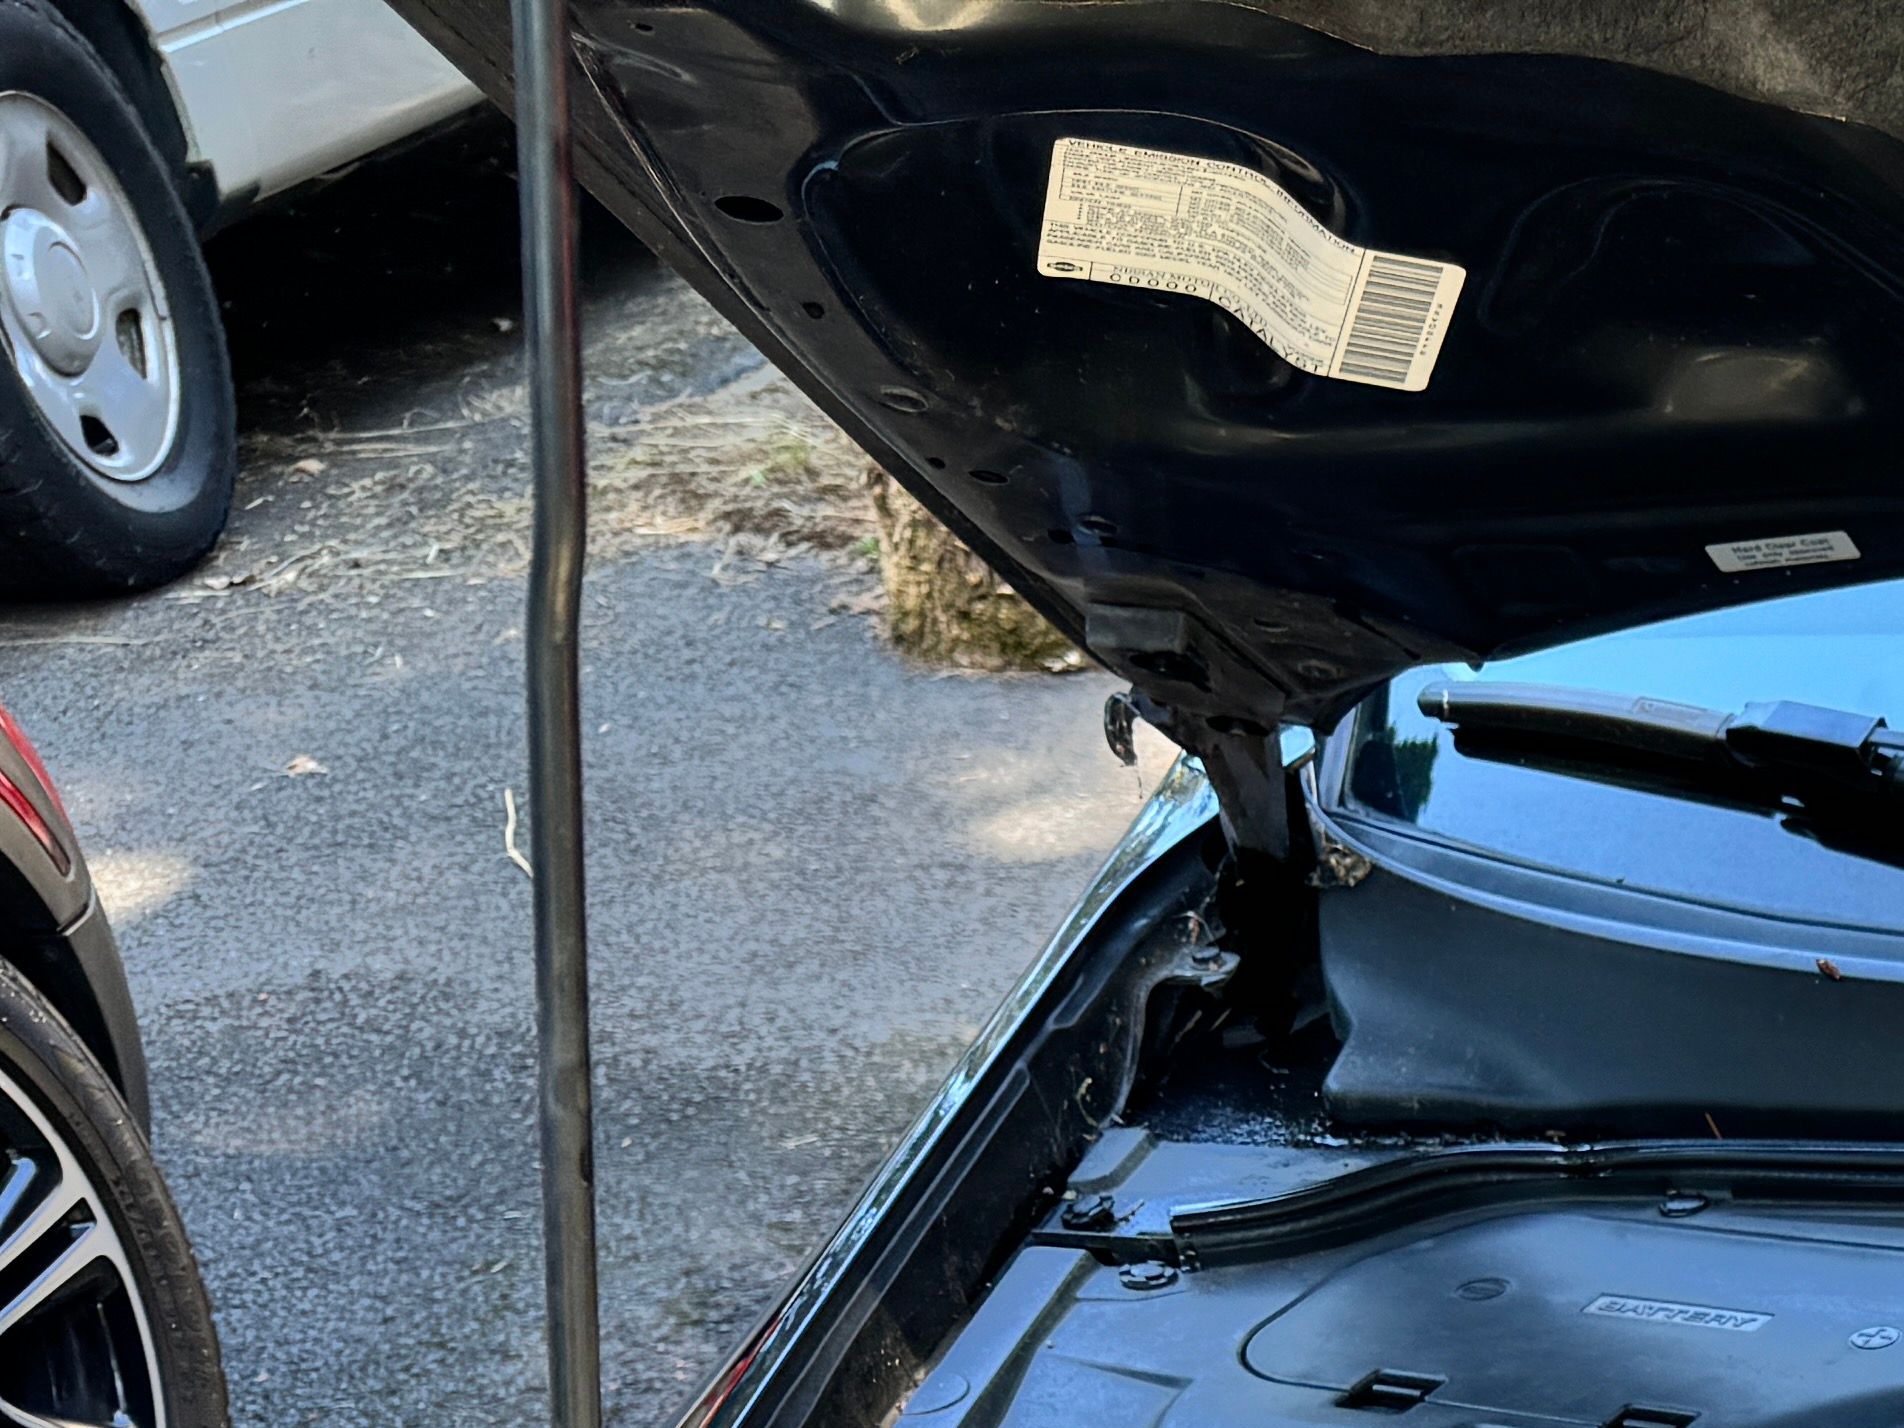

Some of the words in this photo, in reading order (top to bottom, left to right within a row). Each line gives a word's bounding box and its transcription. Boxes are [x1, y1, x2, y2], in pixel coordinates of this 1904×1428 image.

[1067, 139, 1128, 153] VEHICLE
[1217, 295, 1319, 373] CATALYST
[1600, 1299, 1759, 1330] BATTERY
